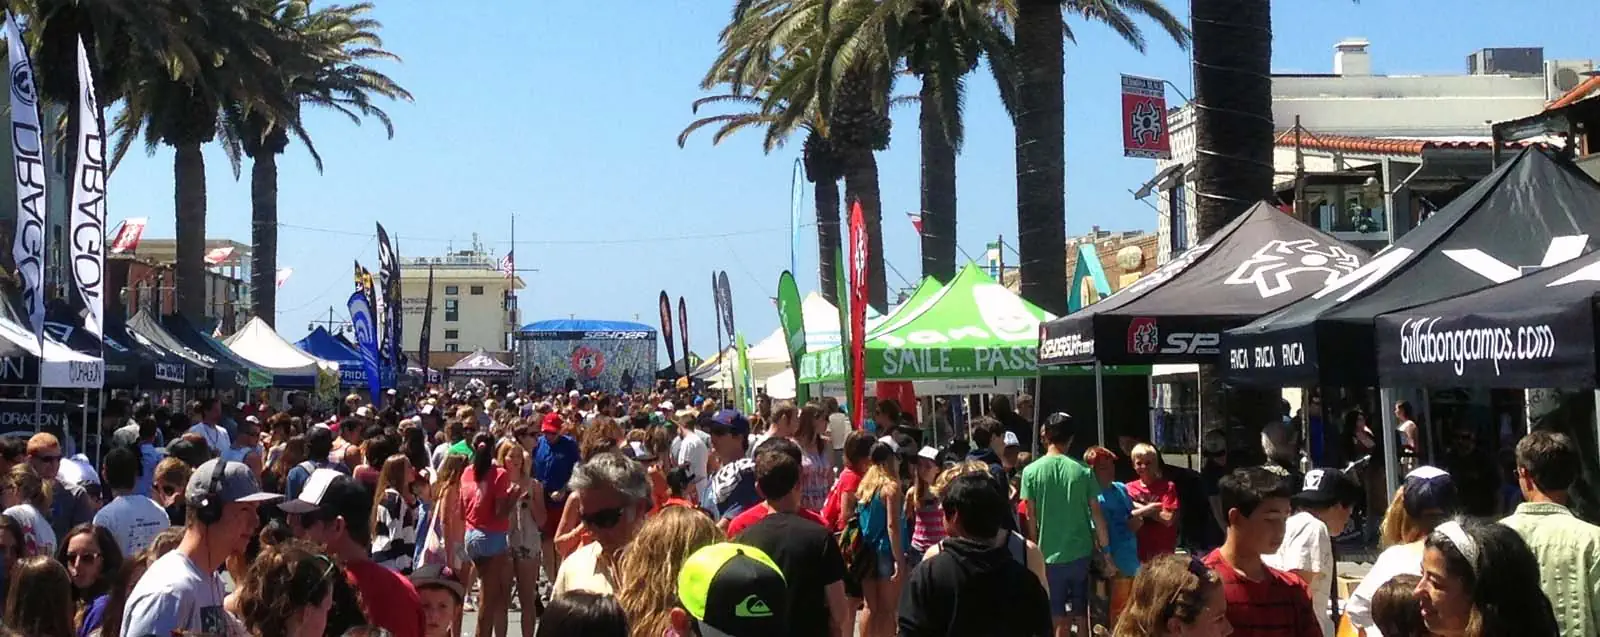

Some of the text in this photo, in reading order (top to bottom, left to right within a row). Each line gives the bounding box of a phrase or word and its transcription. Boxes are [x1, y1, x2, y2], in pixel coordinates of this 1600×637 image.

[1255, 345, 1276, 368] RVCA
[1282, 342, 1305, 366] RVCA
[1400, 316, 1555, 376] billabongcamps.com
[975, 346, 1038, 372] PASS
[1230, 348, 1249, 369] RVCA
[2, 412, 60, 426] DRAGON
